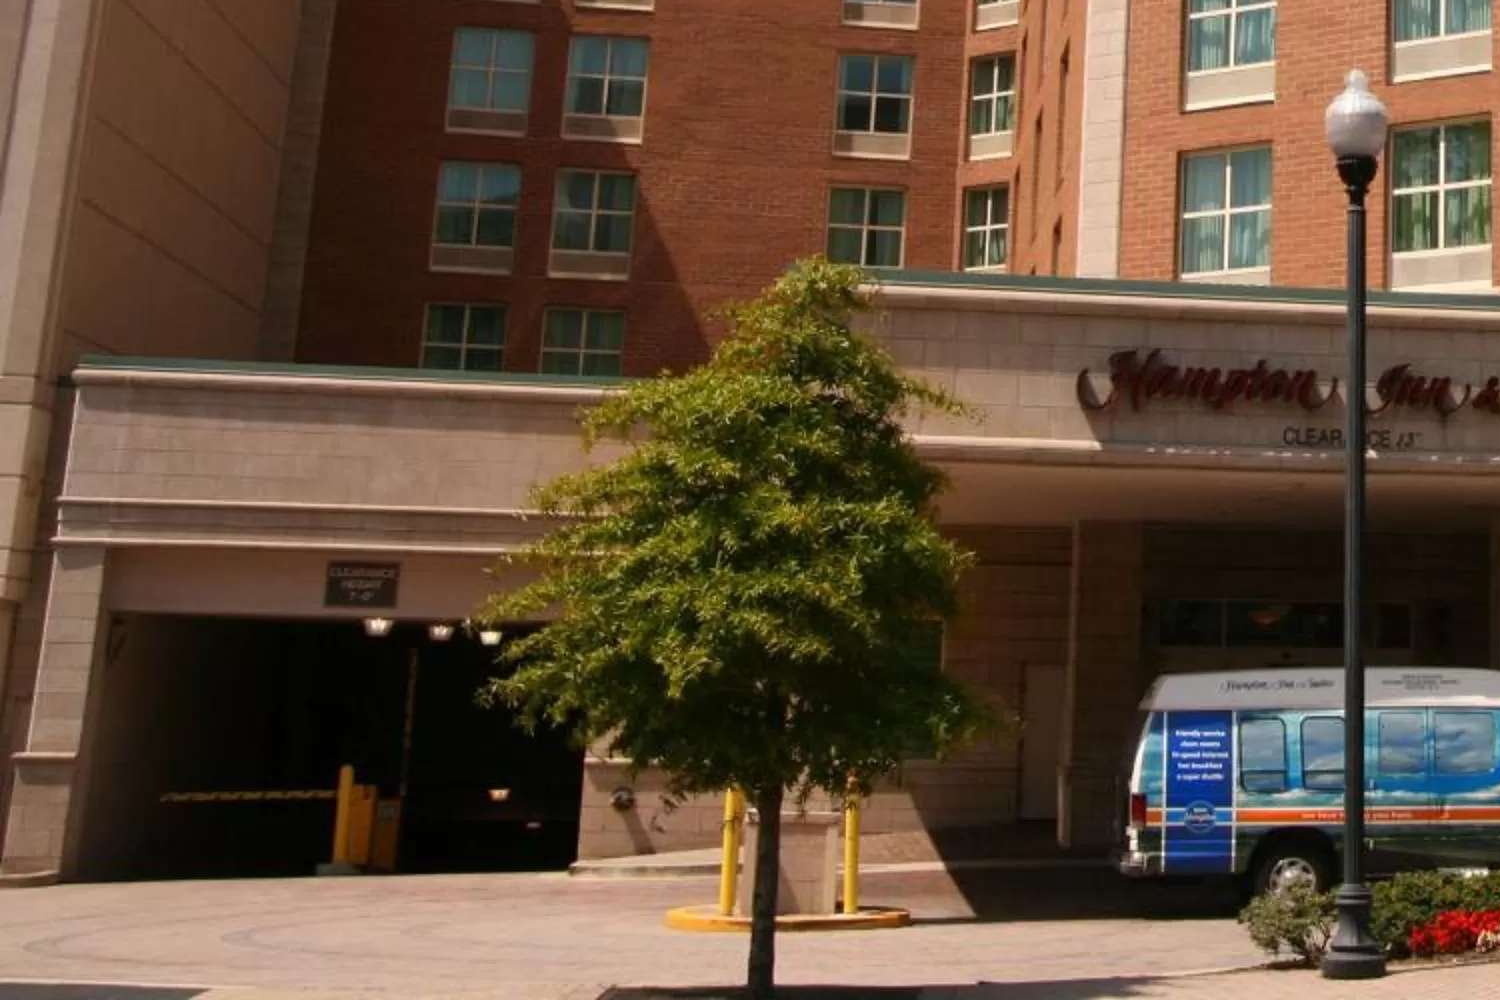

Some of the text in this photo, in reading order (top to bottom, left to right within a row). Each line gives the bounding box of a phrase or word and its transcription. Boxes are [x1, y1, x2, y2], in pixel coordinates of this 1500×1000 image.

[1076, 347, 1339, 412] Hampton
[1366, 362, 1471, 414] Inn
[1283, 426, 1391, 448] CLEARCE
